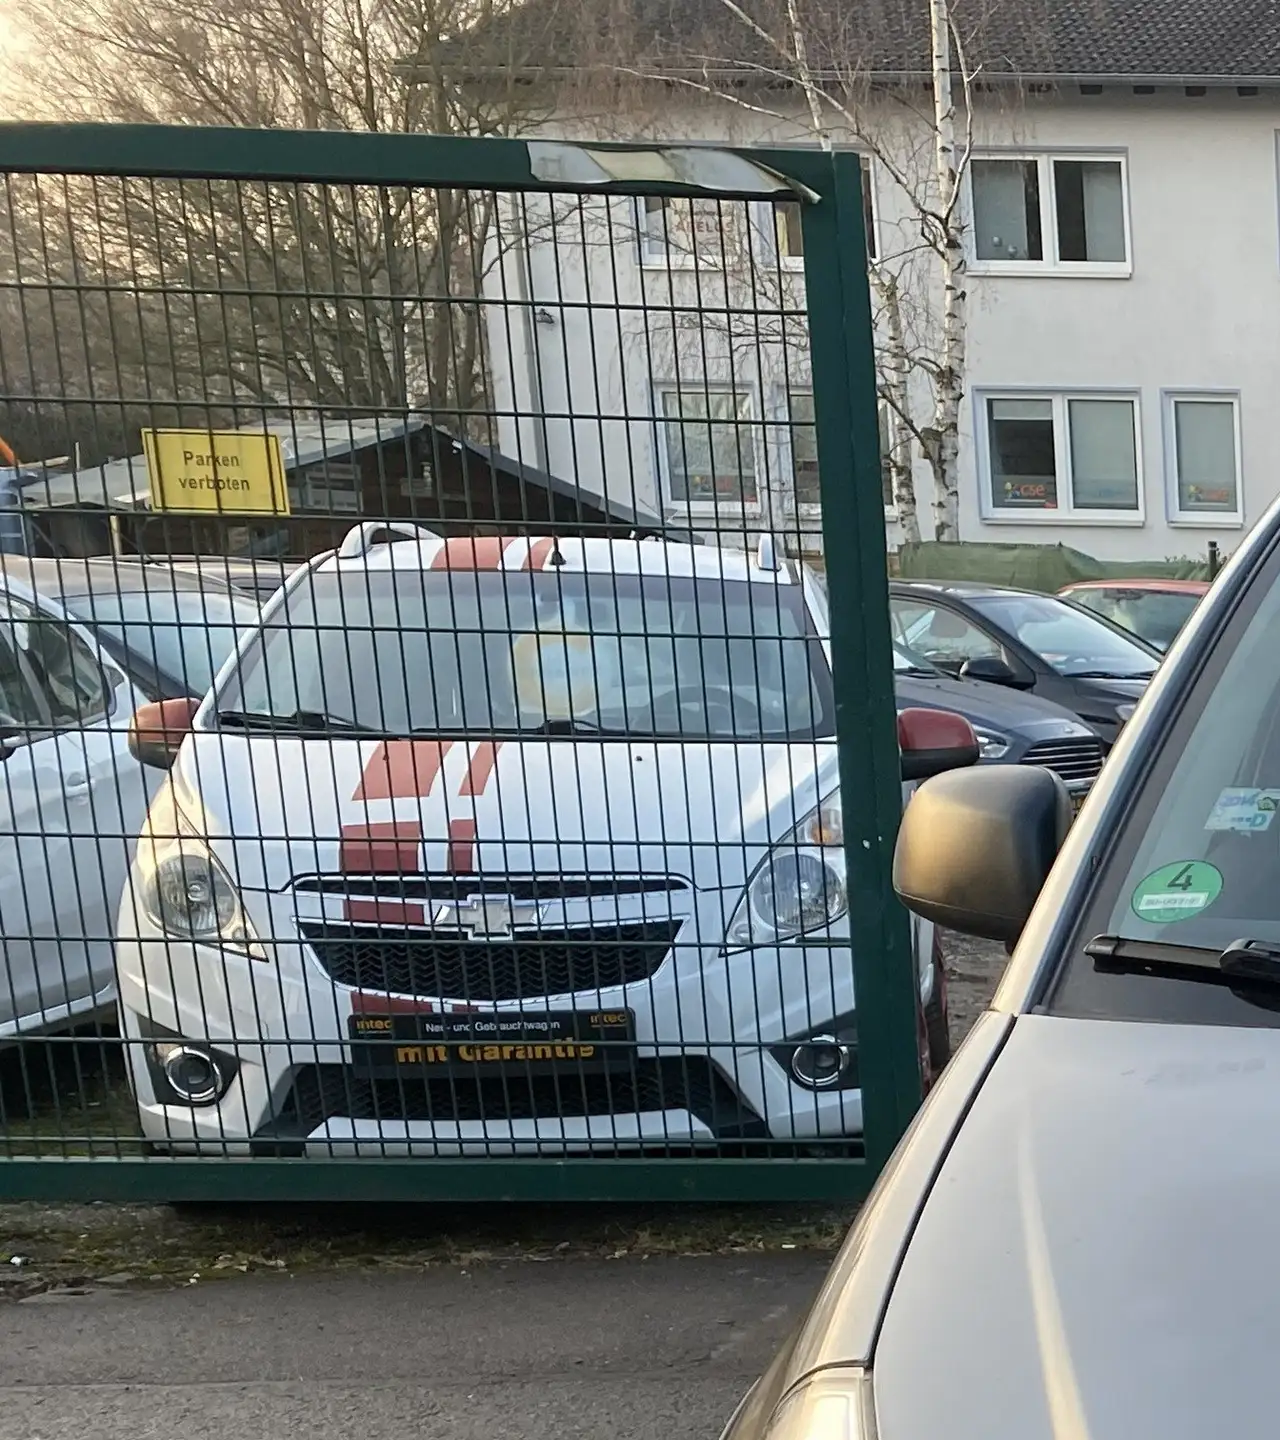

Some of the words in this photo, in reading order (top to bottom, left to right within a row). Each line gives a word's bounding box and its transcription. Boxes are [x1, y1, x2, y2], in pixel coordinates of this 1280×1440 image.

[183, 449, 240, 467] Parken
[178, 474, 250, 491] verboten
[1167, 863, 1195, 891] 4
